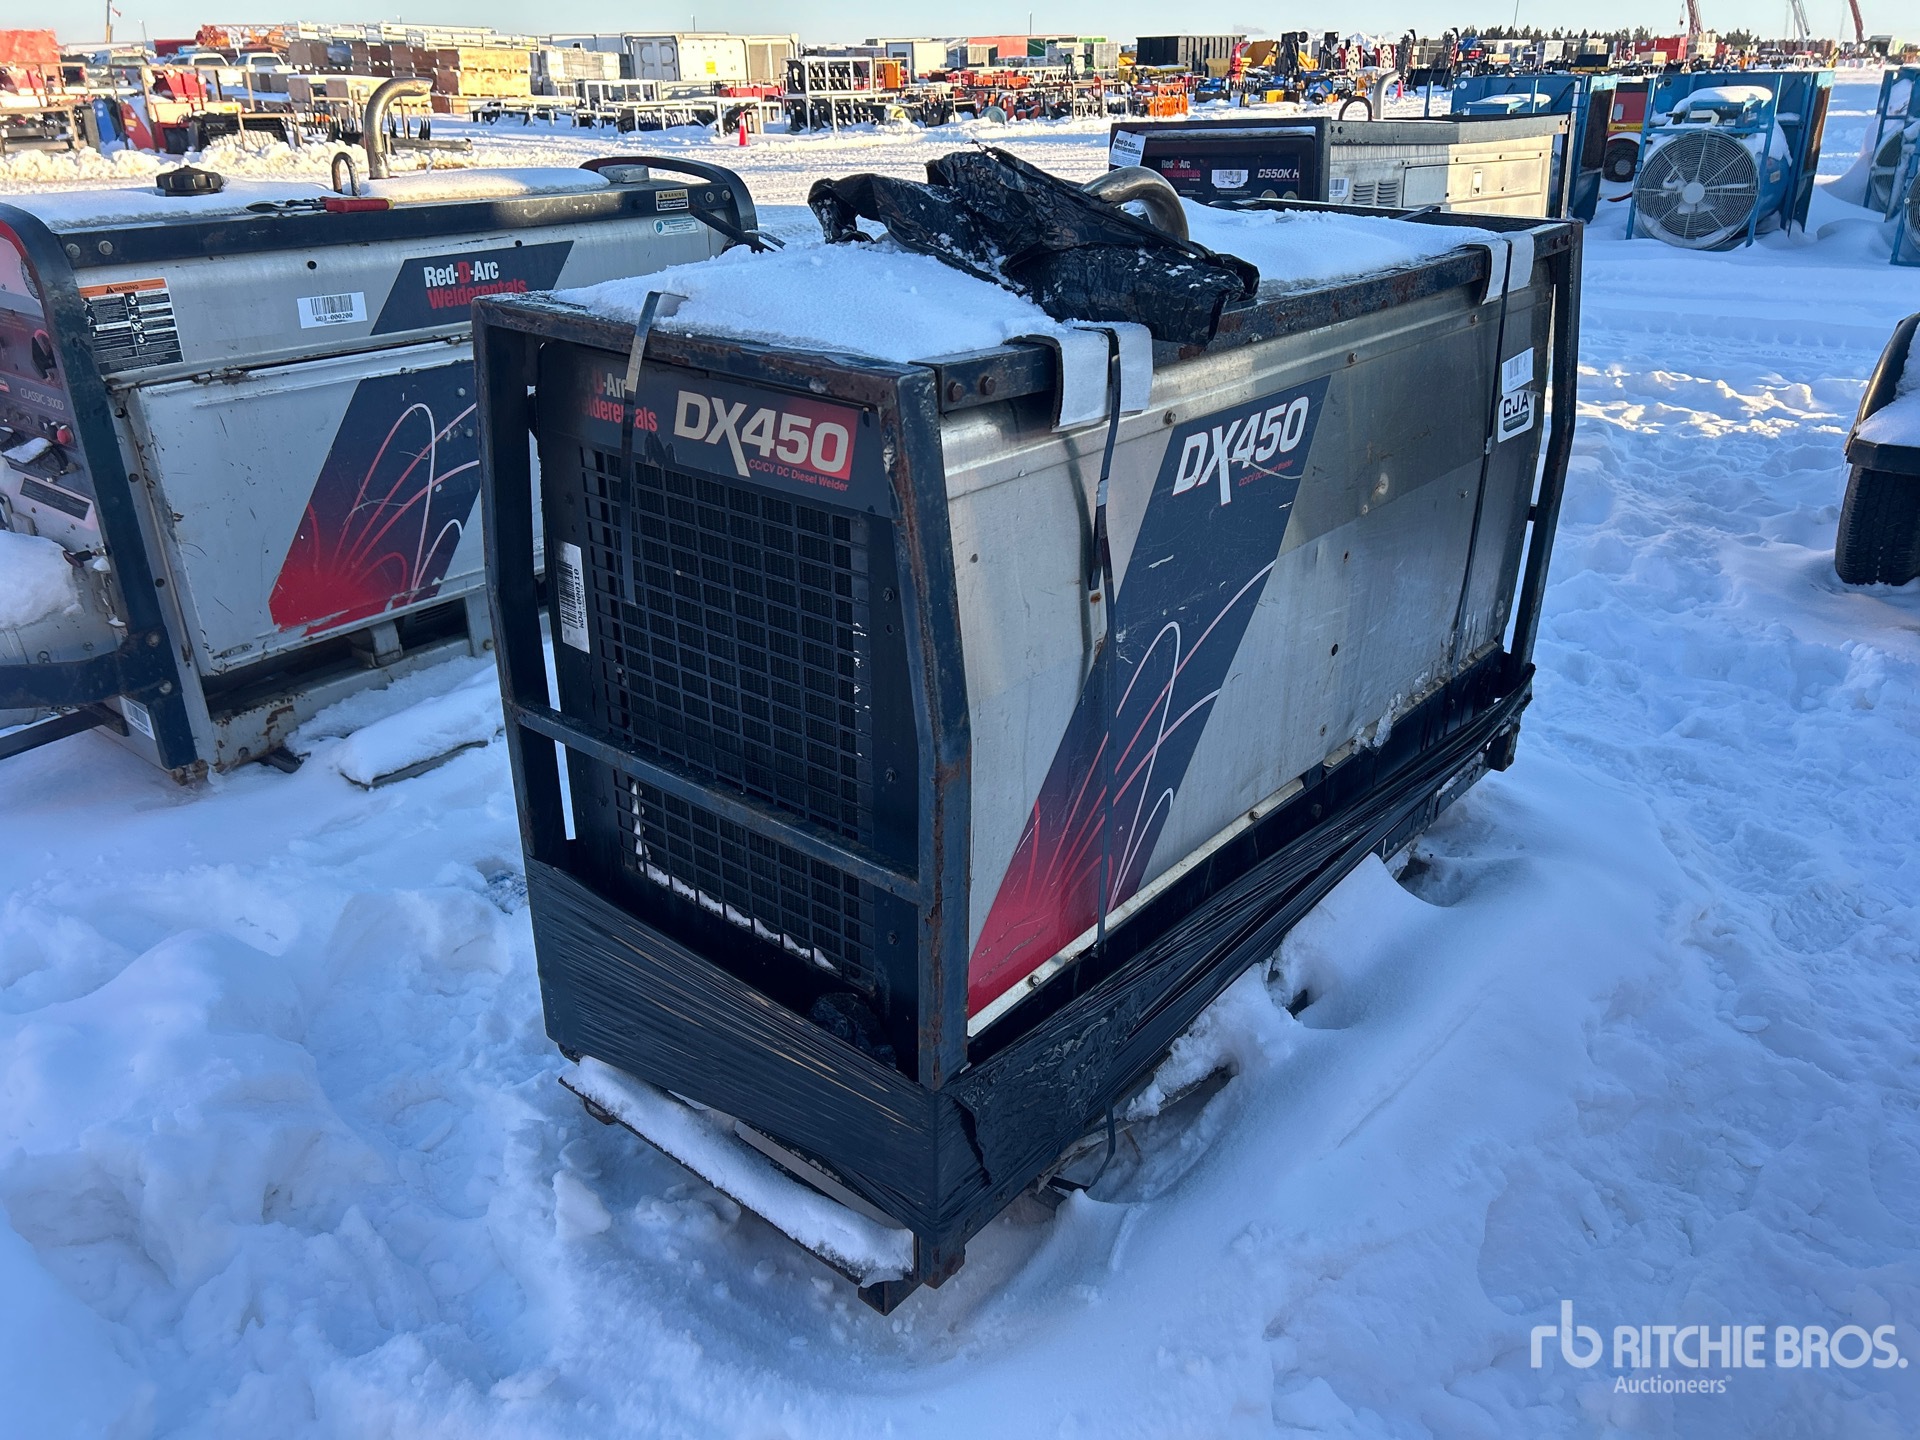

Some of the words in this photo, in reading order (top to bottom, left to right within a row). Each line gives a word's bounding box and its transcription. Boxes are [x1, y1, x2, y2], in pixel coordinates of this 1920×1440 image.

[1257, 168, 1290, 179] D550K
[114, 284, 140, 293] WARNING
[20, 387, 46, 405] CLASSIC
[1503, 392, 1529, 418] CJA
[673, 390, 850, 478] DX450
[1172, 396, 1310, 507] DX450
[748, 458, 775, 473] CC/CV
[776, 466, 790, 477] DC
[791, 469, 817, 484] Diesel
[818, 476, 849, 491] Welder
